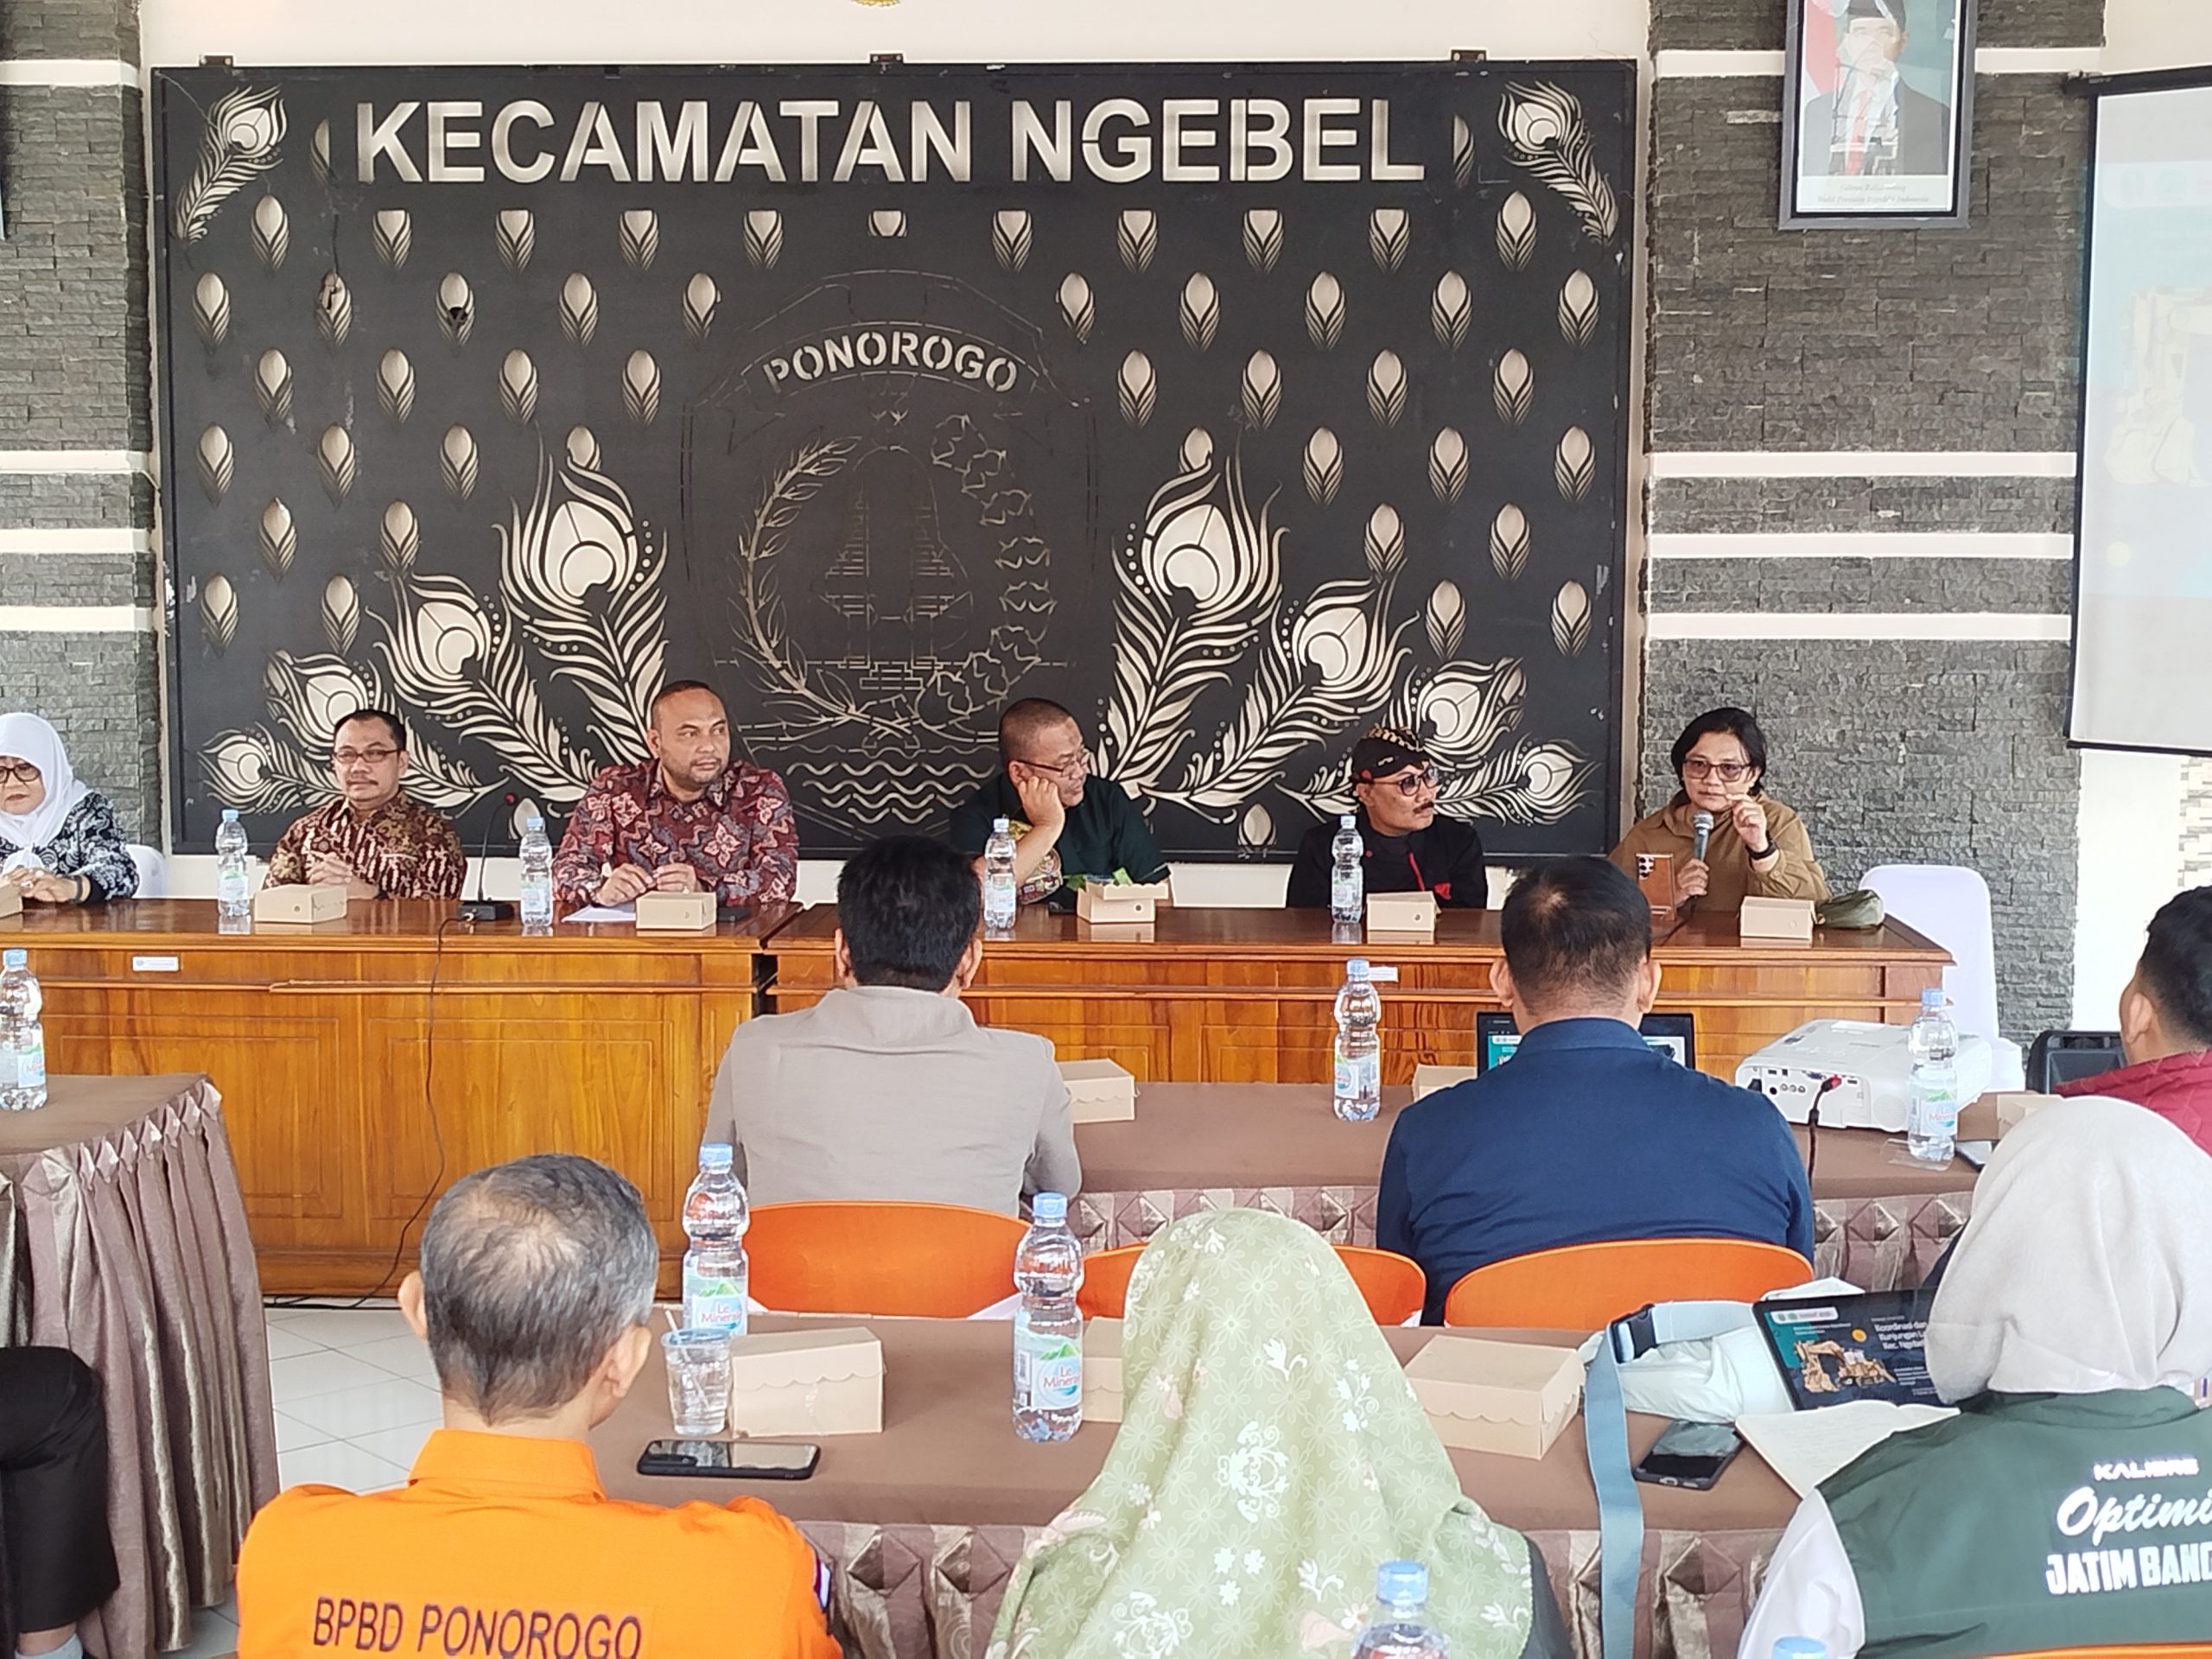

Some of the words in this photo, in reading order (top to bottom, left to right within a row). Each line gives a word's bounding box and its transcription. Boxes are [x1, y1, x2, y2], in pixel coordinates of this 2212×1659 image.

[356, 99, 972, 184] KECAMATAN
[1012, 98, 1425, 183] NGEBEL
[762, 330, 1018, 394] PONOROGO
[717, 1304, 729, 1313] Le
[1060, 1366, 1071, 1376] Le
[2045, 1548, 2138, 1595] JATIM
[314, 1597, 404, 1653] BPBD
[416, 1604, 642, 1659] PONOROGO
